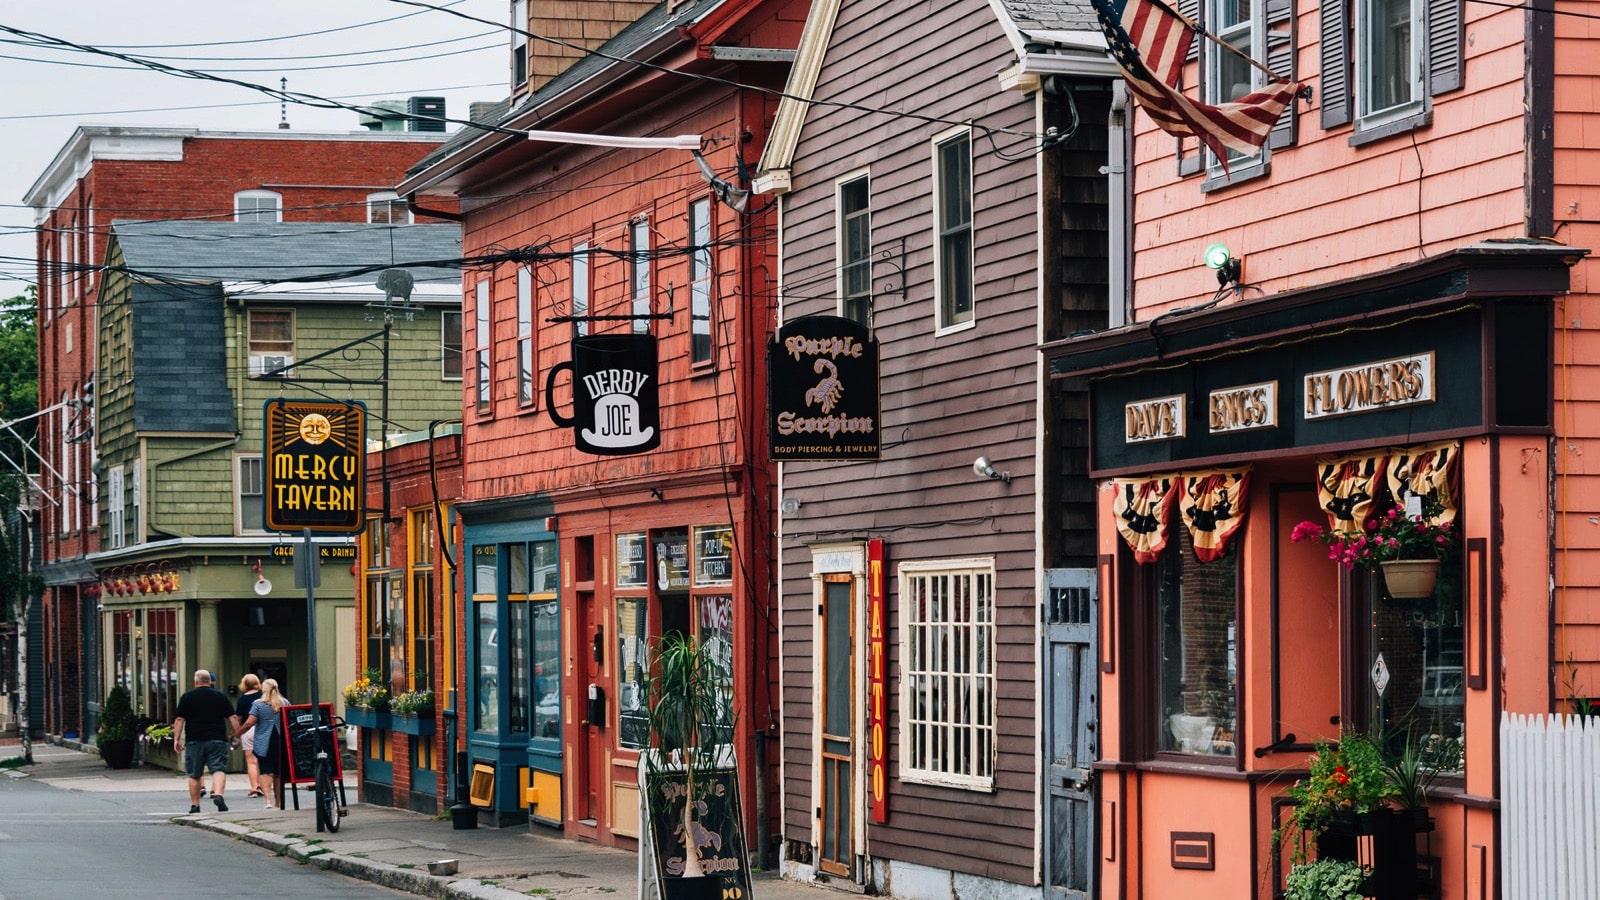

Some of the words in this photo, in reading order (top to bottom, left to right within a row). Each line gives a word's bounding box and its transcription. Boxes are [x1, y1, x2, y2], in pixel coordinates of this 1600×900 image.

[785, 335, 864, 362] Purple
[582, 368, 649, 400] DERBY
[1126, 399, 1178, 439] DAVE
[1305, 359, 1423, 415] FLOWERS
[601, 404, 632, 437] JOE
[777, 411, 874, 439] Scorpion
[774, 445, 796, 454] BODY
[798, 445, 833, 453] PIERCING
[835, 445, 842, 453] &
[843, 445, 878, 453] JEWELRY
[274, 453, 356, 481] MERCY
[274, 484, 356, 511] TAVERN
[273, 546, 294, 557] GREA
[320, 547, 330, 557] &
[332, 547, 355, 558] DRINK
[705, 538, 723, 554] POP-UP
[703, 560, 726, 576] KITCHEN
[871, 559, 885, 802] TATTOO
